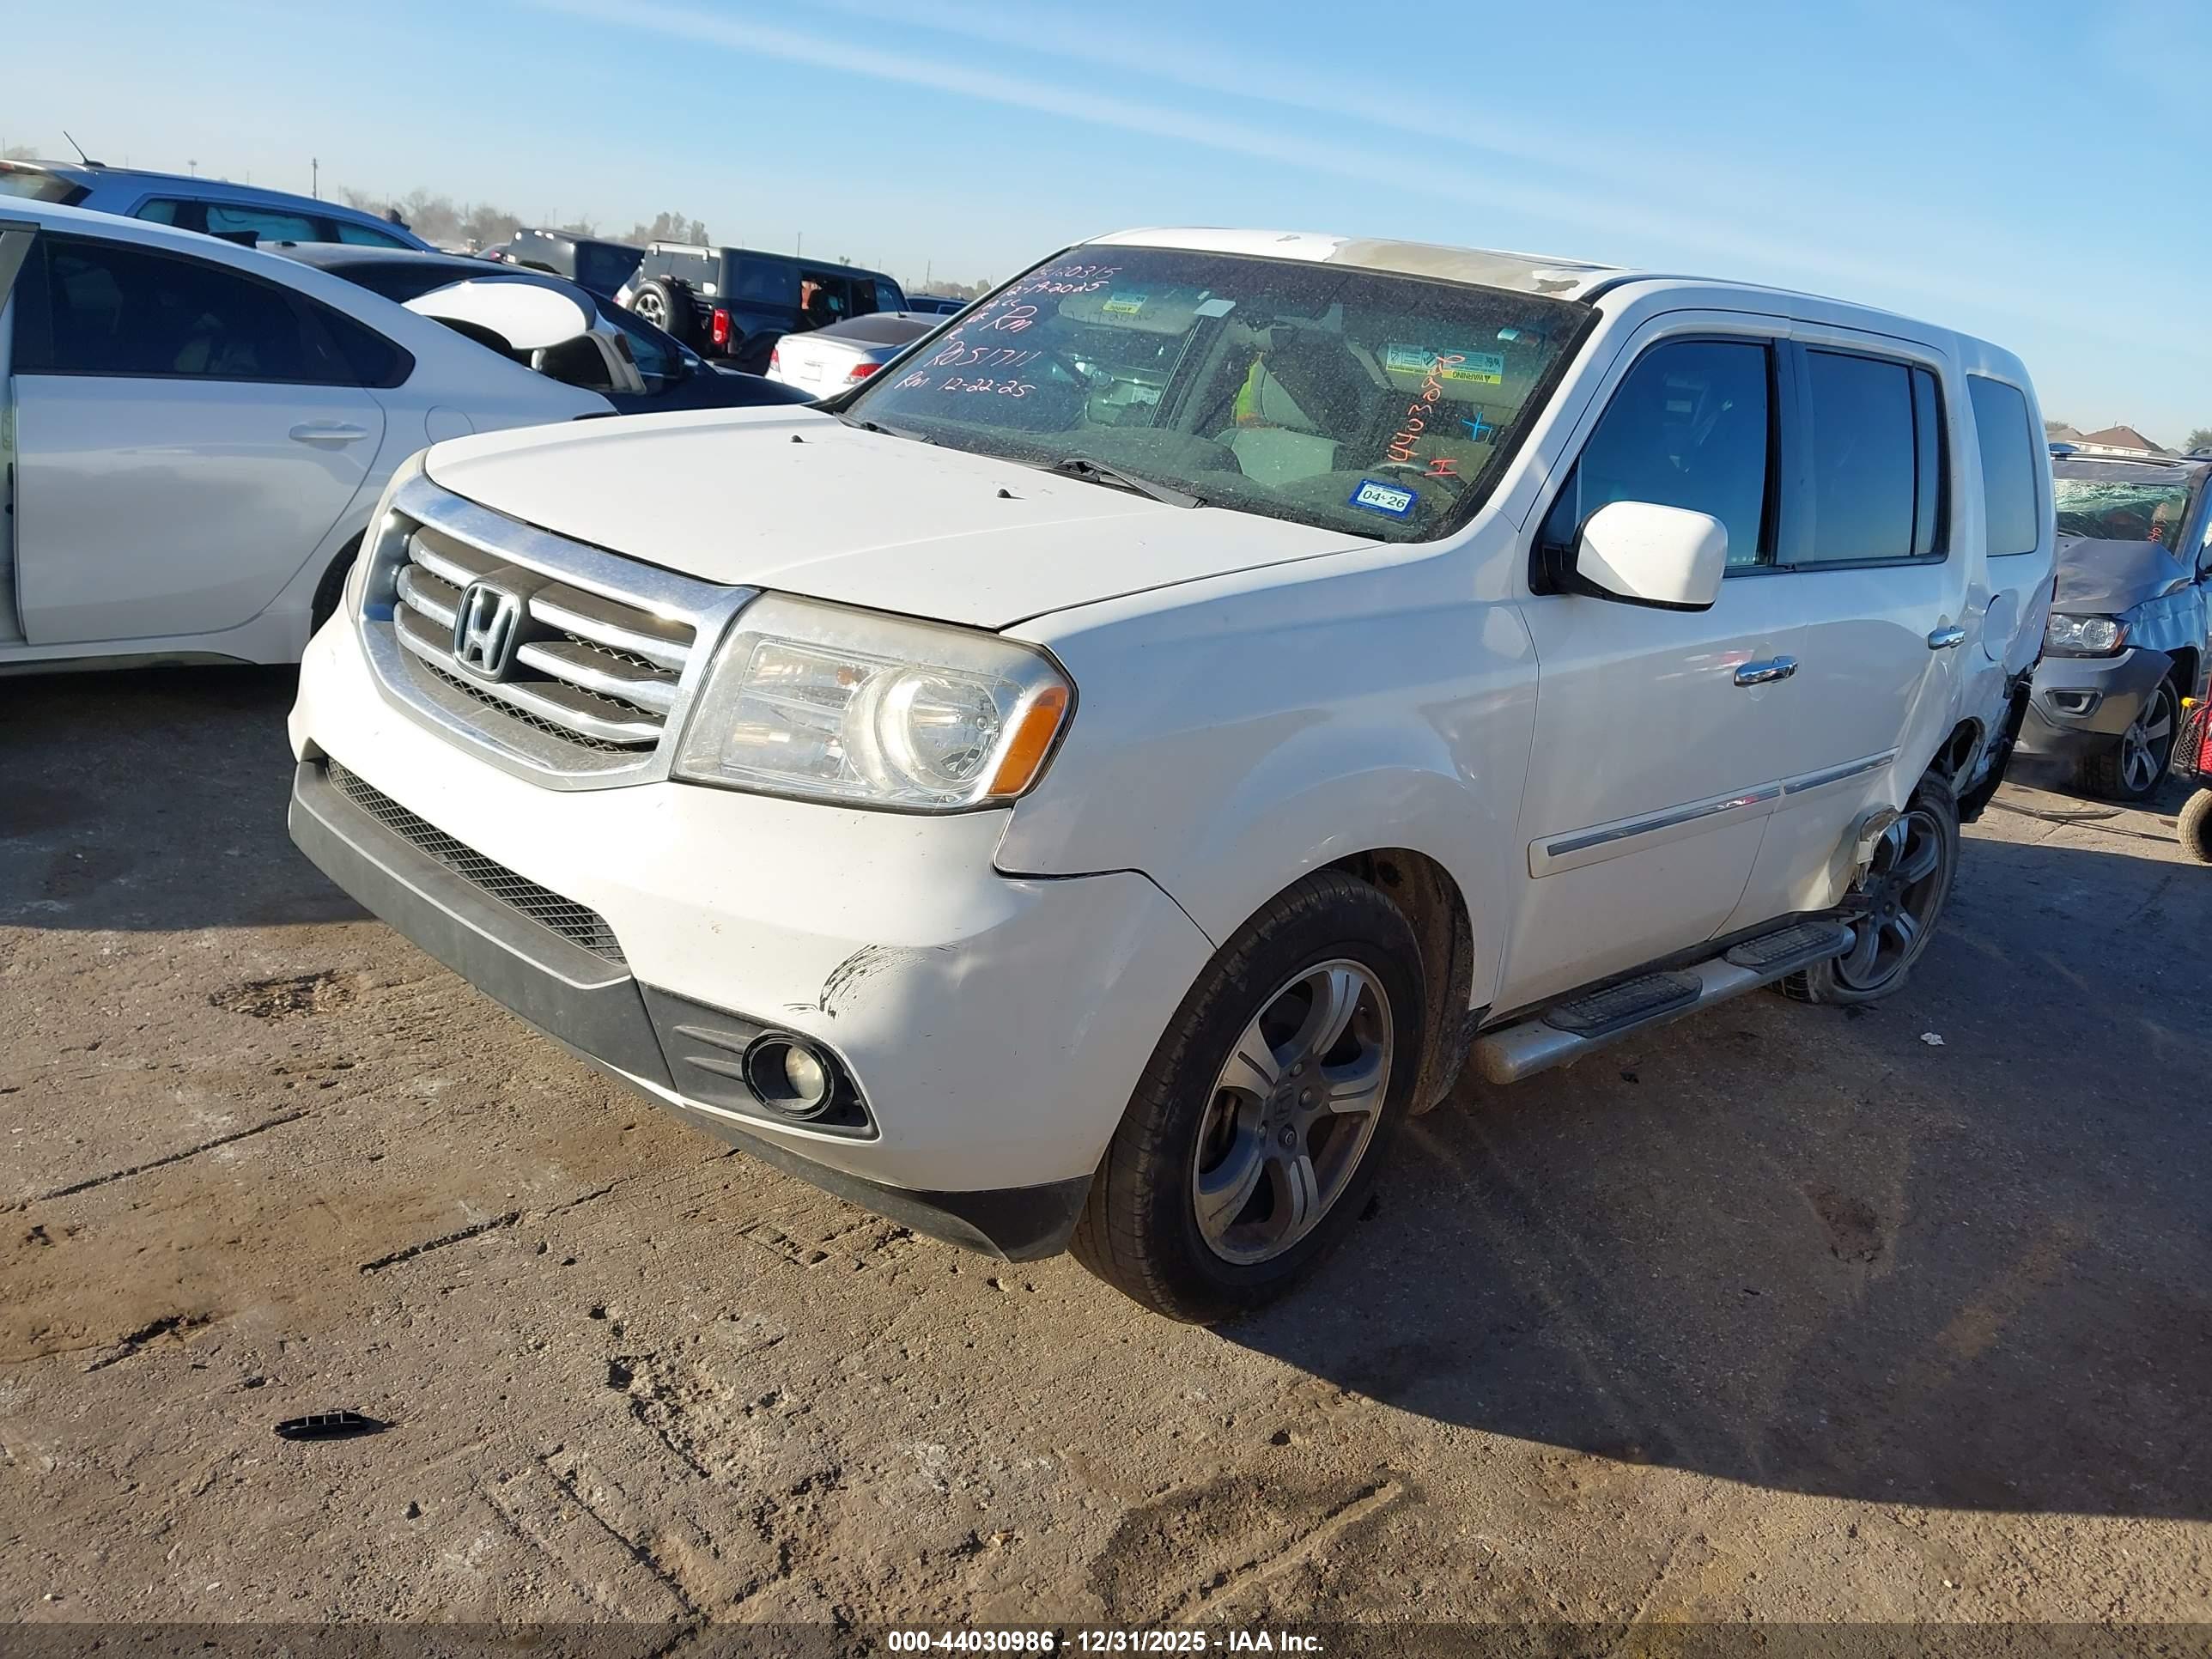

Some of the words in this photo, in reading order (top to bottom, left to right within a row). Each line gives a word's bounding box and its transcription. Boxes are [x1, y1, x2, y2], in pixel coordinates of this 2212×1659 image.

[1451, 370, 1484, 381] WARNING
[936, 377, 1036, 398] 12-22-25
[1362, 489, 1382, 502] 04
[1386, 495, 1407, 508] 26
